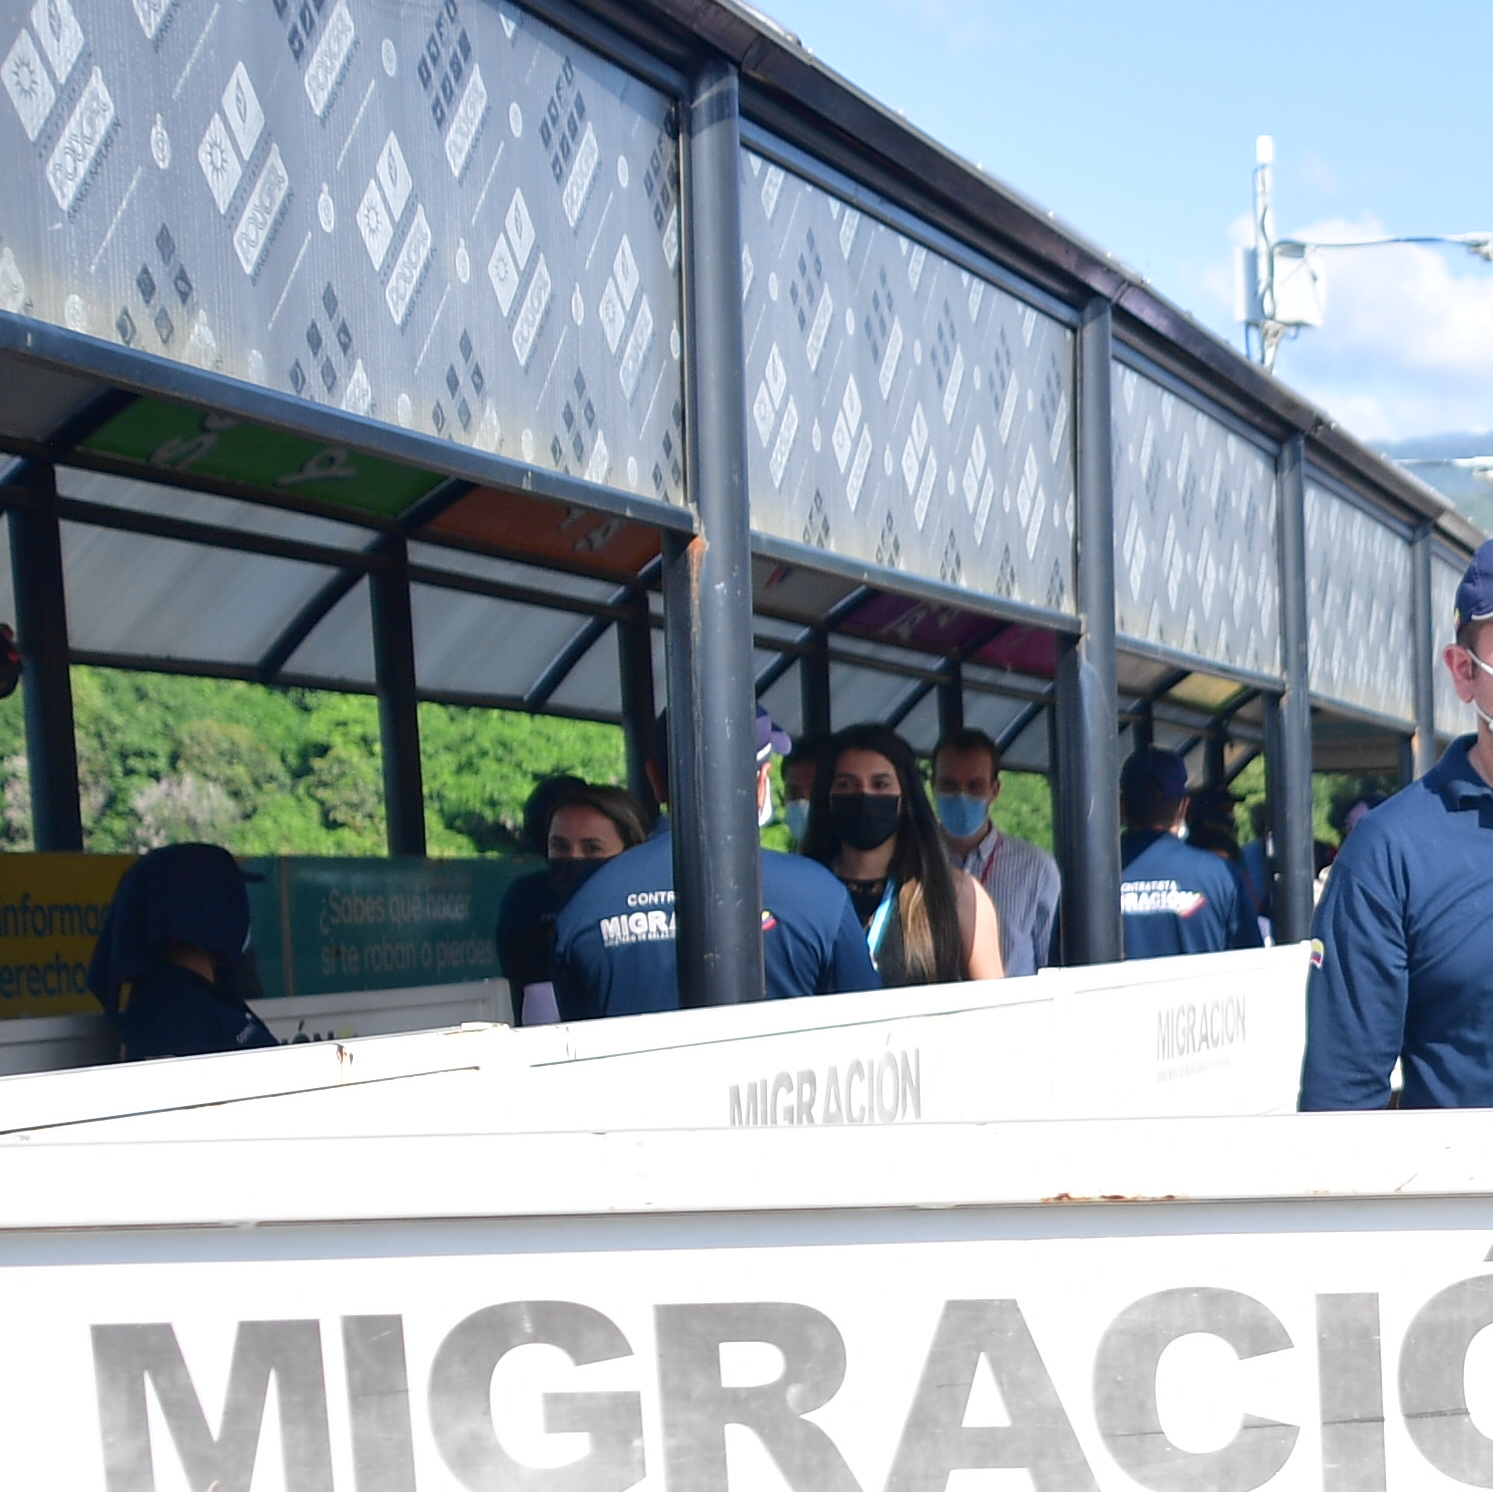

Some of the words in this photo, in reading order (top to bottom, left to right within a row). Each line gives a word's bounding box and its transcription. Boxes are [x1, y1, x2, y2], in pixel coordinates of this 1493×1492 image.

[319, 888, 384, 934] ¿Sabes
[426, 884, 471, 920] hacer
[365, 934, 417, 972] roban
[437, 932, 494, 974] pierdes
[728, 1034, 921, 1126] MIGRACIÓN
